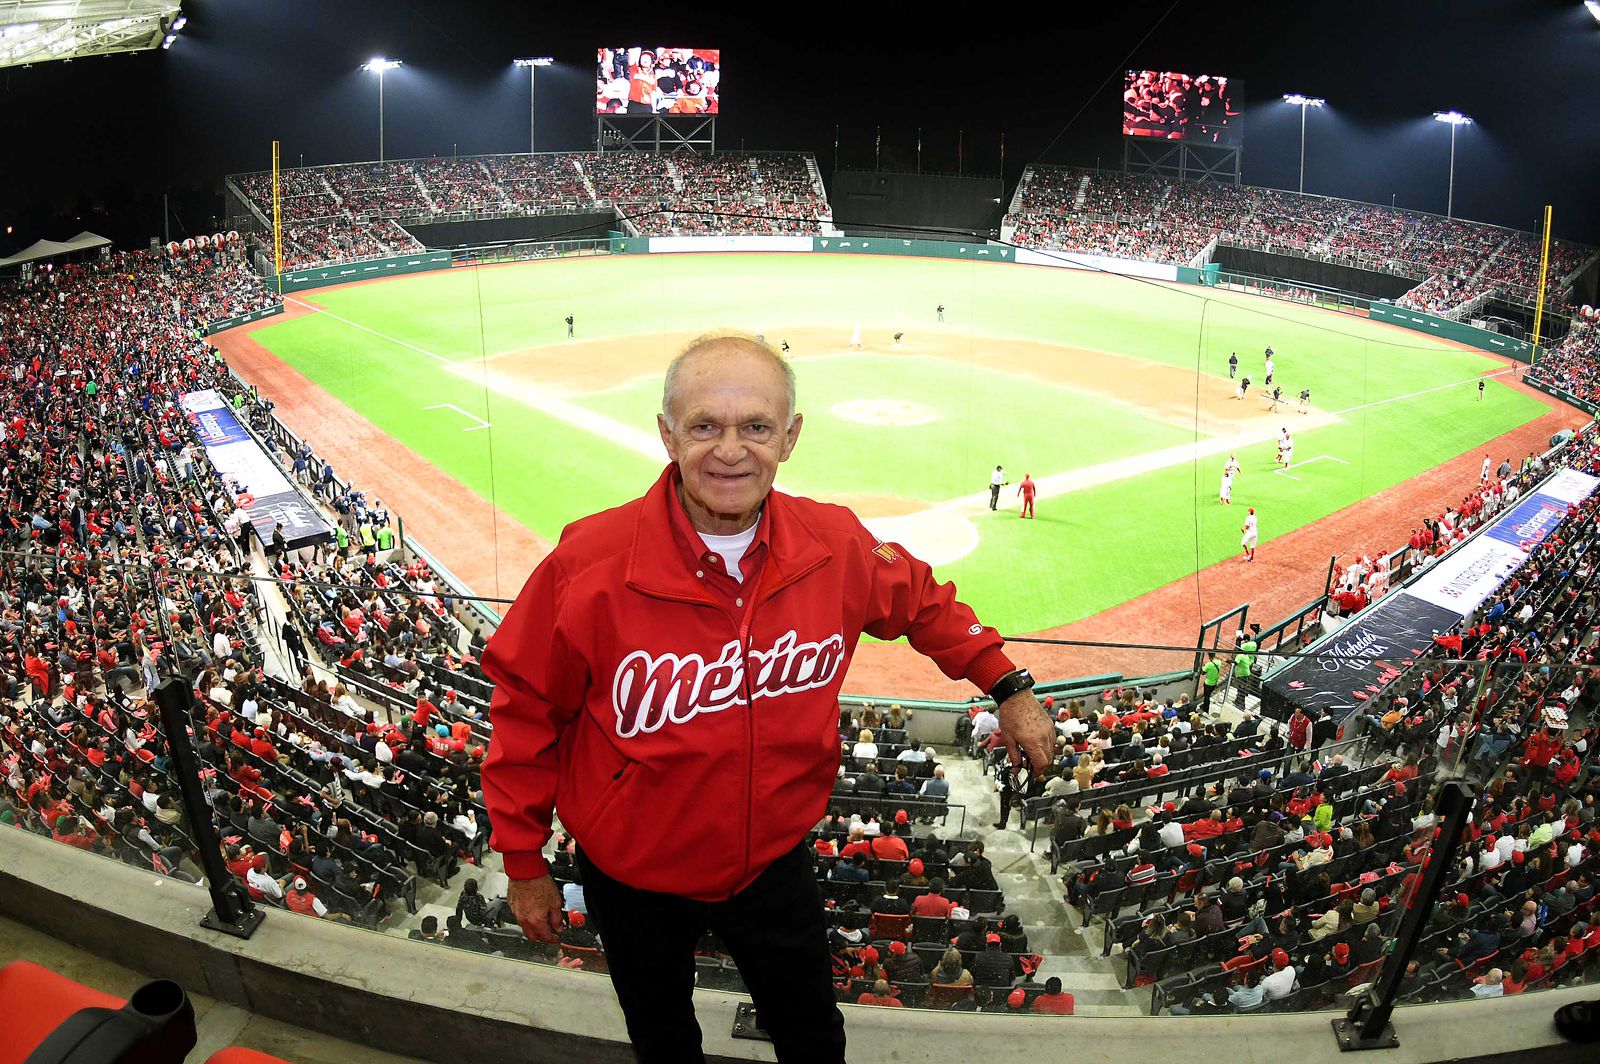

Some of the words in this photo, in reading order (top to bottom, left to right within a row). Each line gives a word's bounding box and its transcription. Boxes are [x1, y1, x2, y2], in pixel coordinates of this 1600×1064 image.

[21, 263, 31, 271] B7
[1317, 626, 1377, 672] Michelob
[1345, 643, 1389, 670] ULTRA
[612, 629, 845, 739] México
